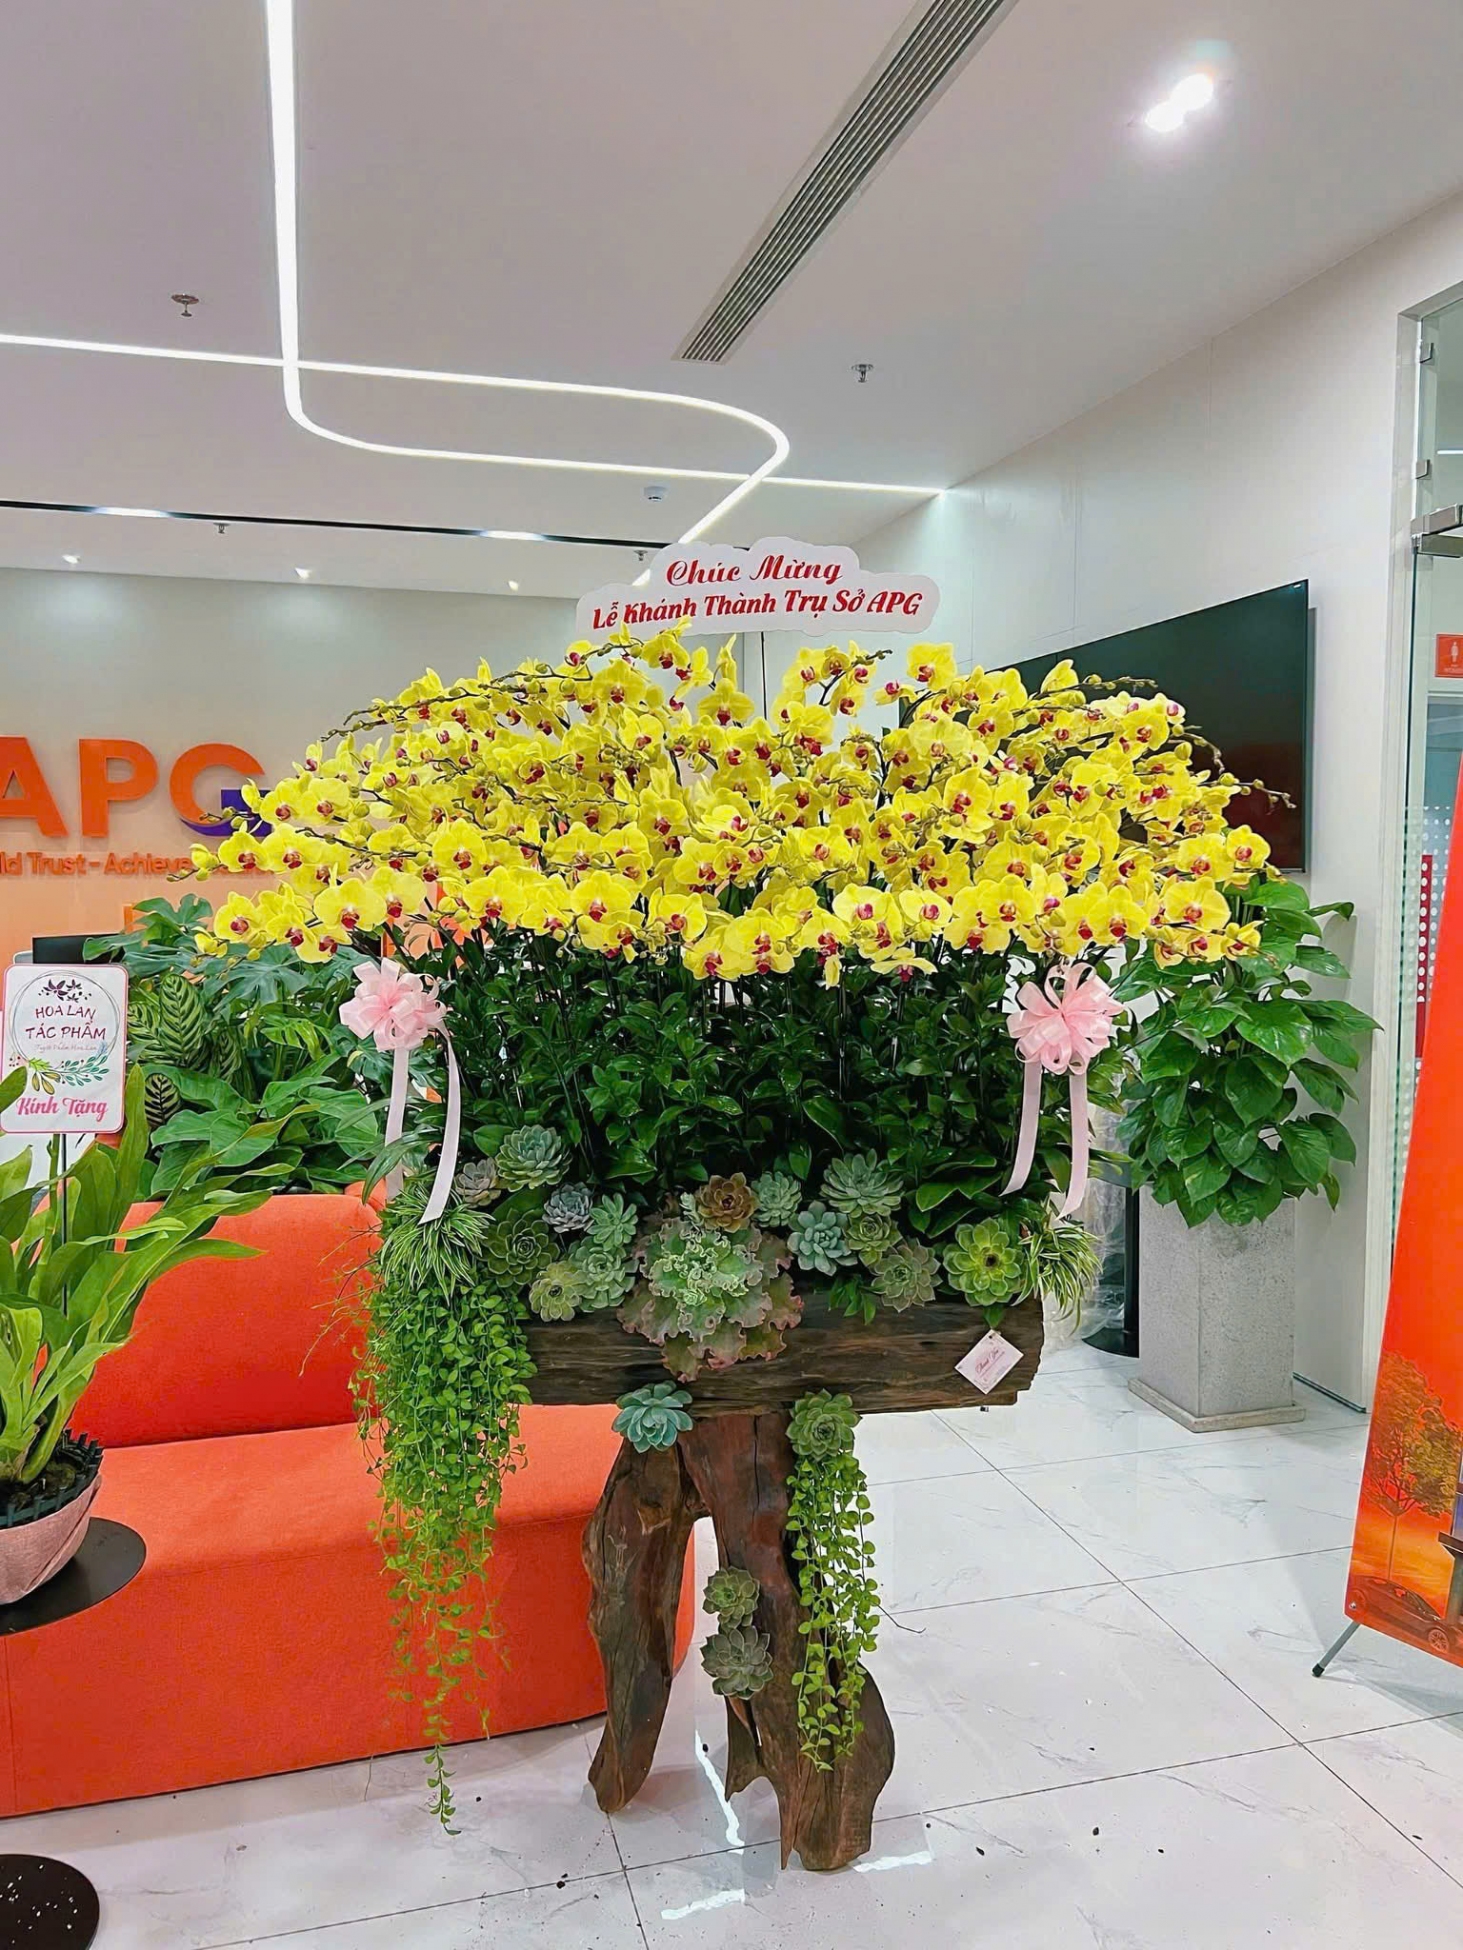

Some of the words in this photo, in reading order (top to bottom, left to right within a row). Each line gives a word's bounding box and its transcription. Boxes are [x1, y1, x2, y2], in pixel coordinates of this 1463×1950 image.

[666, 559, 742, 586] Chúc
[750, 554, 843, 585] Mừng
[593, 601, 617, 630] Lễ
[624, 595, 696, 625] Khánh
[704, 592, 777, 617] Thành
[784, 589, 831, 619] Trụ
[832, 590, 866, 613] Sở
[866, 591, 923, 616] APG
[0, 737, 273, 837] APG
[26, 851, 86, 876] Trust
[35, 1005, 64, 1019] HOA
[66, 1004, 97, 1020] LAN
[26, 1023, 57, 1040] TÁC
[61, 1020, 107, 1040] PHẨM
[16, 1096, 59, 1116] Kính
[63, 1097, 109, 1122] Tặng
